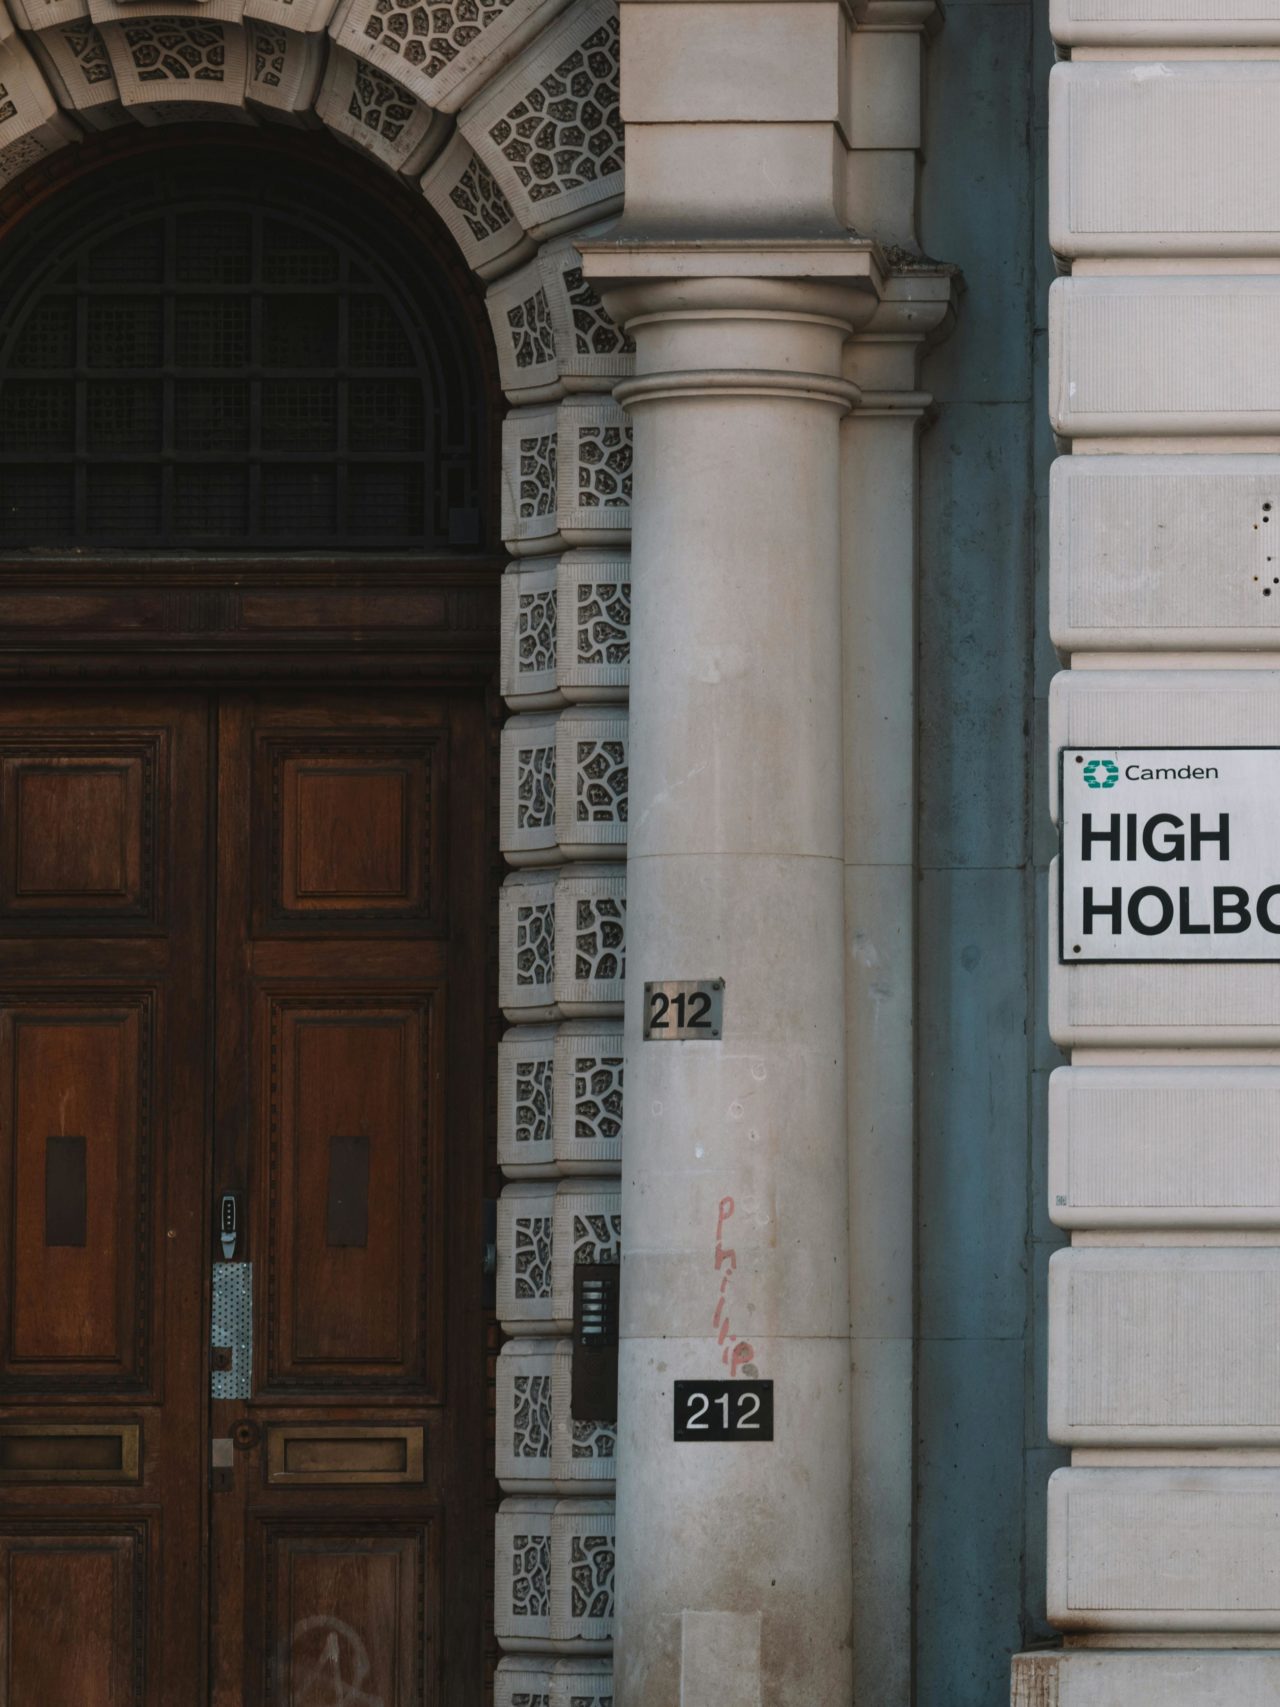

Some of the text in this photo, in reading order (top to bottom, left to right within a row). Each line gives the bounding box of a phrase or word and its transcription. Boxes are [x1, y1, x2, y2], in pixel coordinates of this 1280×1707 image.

[1125, 765, 1219, 781] Camden
[1081, 813, 1230, 862] HIGH
[650, 992, 712, 1028] 212
[686, 1392, 761, 1429] 212
